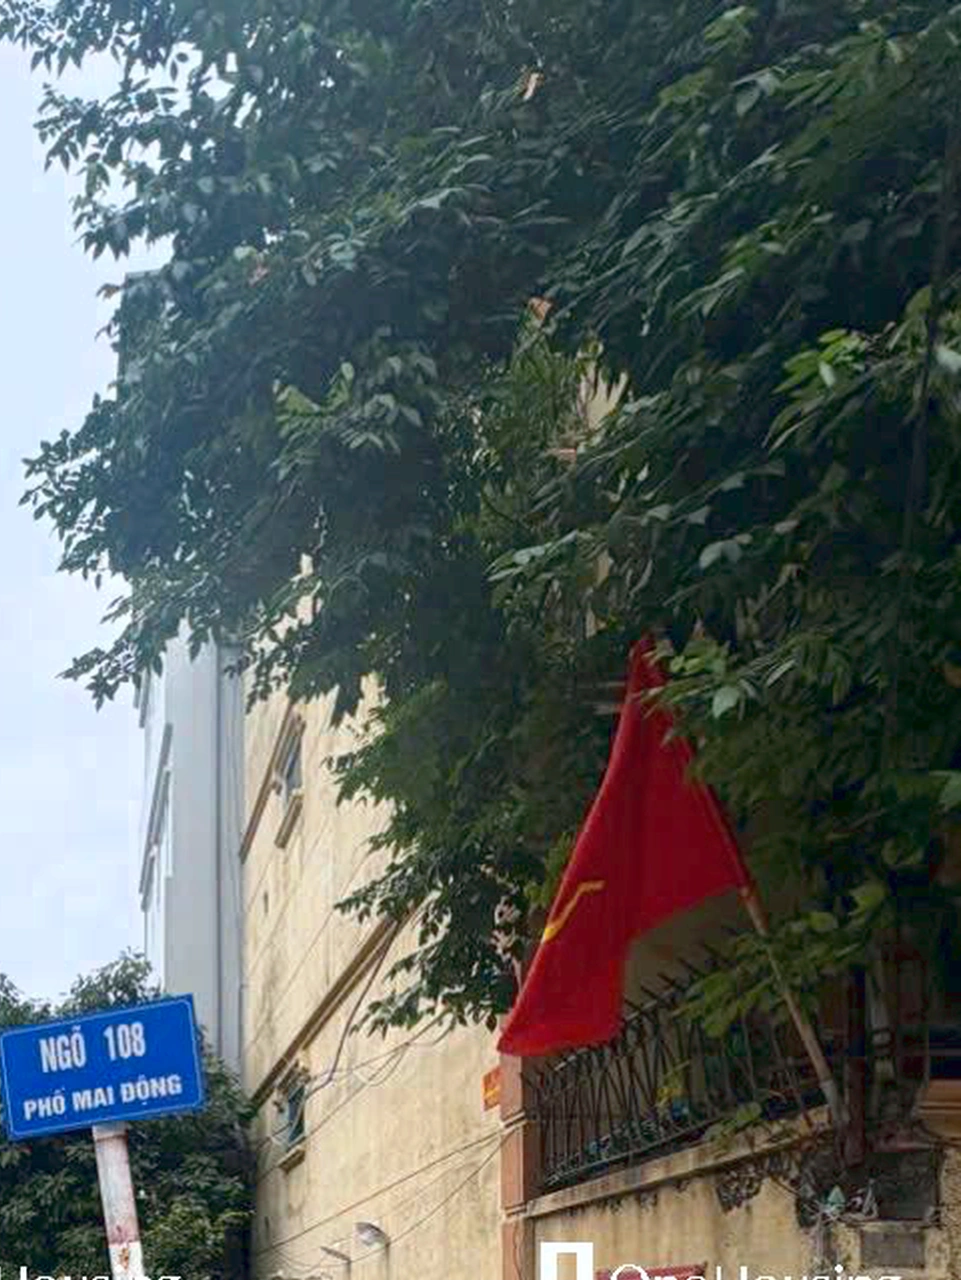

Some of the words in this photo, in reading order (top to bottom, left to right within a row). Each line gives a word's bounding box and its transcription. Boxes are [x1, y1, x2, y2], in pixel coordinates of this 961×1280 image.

[39, 1026, 86, 1073] NGÕ
[103, 1022, 147, 1061] 108
[23, 1086, 66, 1121] PHỐ
[72, 1086, 115, 1111] MAI
[120, 1075, 183, 1105] ĐỘNG
